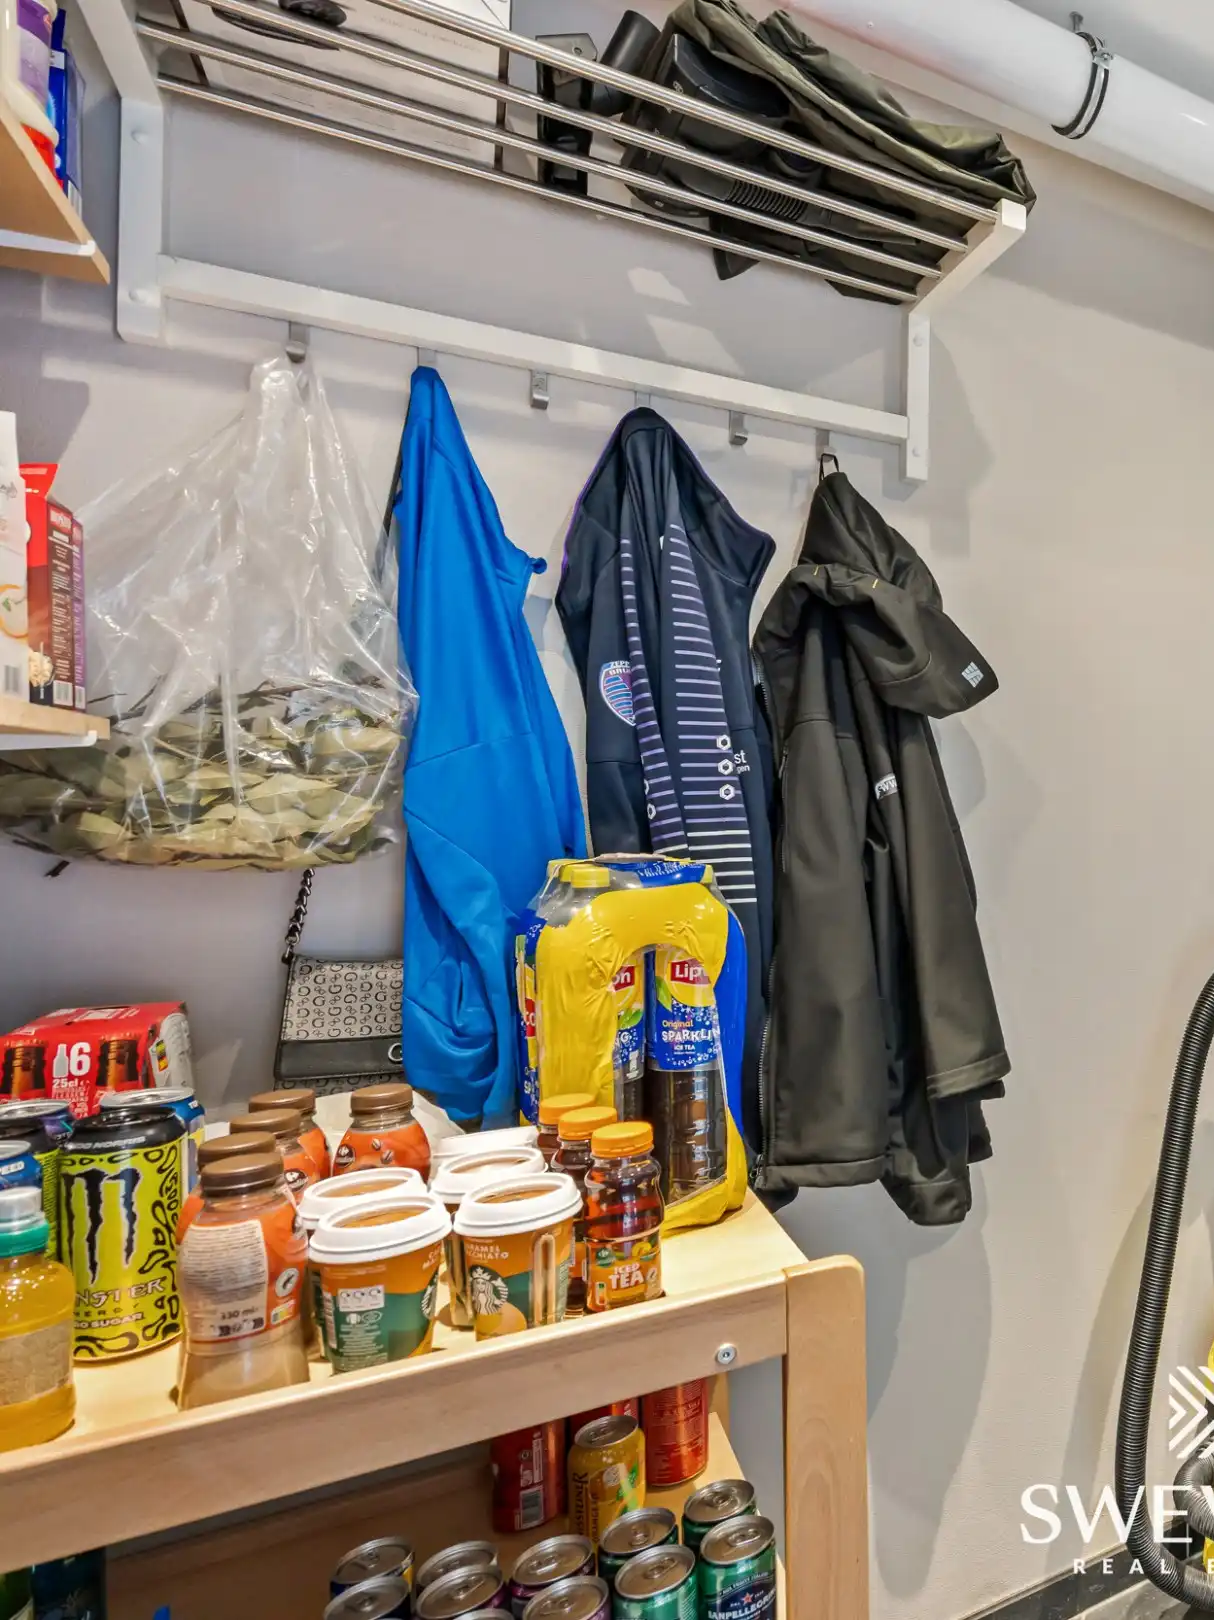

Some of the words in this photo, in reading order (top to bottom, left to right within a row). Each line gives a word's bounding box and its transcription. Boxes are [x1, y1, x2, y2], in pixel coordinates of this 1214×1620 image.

[674, 963, 706, 981] Lip
[661, 1019, 694, 1030] Original
[661, 1026, 720, 1043] SPARKLIN
[69, 1042, 91, 1077] 6
[608, 1270, 644, 1290] TEA
[75, 1276, 167, 1309] NSTER
